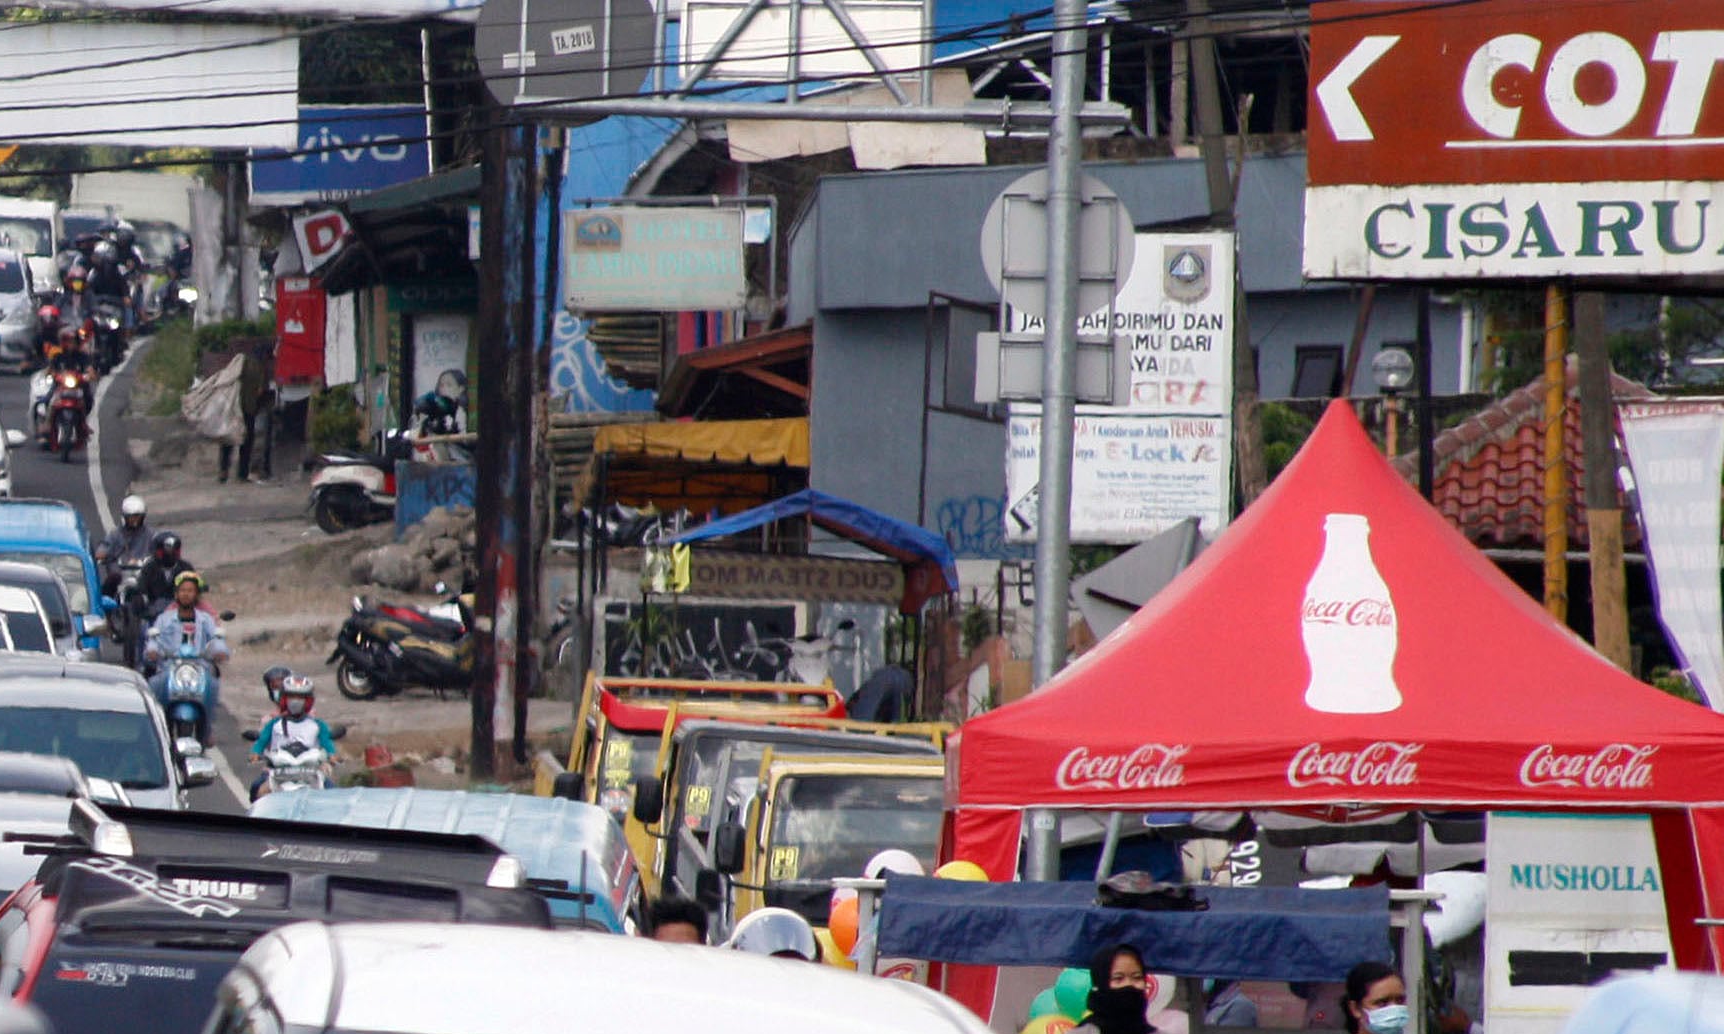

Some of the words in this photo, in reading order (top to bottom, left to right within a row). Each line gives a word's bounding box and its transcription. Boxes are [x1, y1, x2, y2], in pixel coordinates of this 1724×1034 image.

[572, 31, 593, 48] 2018
[632, 219, 731, 242] HOTEL
[1364, 198, 1724, 260] CISARU
[1021, 313, 1109, 331] JAAH
[1184, 313, 1223, 331] DAN
[1171, 335, 1212, 351] DARI
[1056, 743, 1192, 790] Coca-Cola
[1287, 741, 1425, 788] Coca-Cola
[1520, 743, 1660, 789] Coca-Cola
[172, 878, 259, 900] THULE
[1509, 863, 1659, 892] MUSHOLLA
